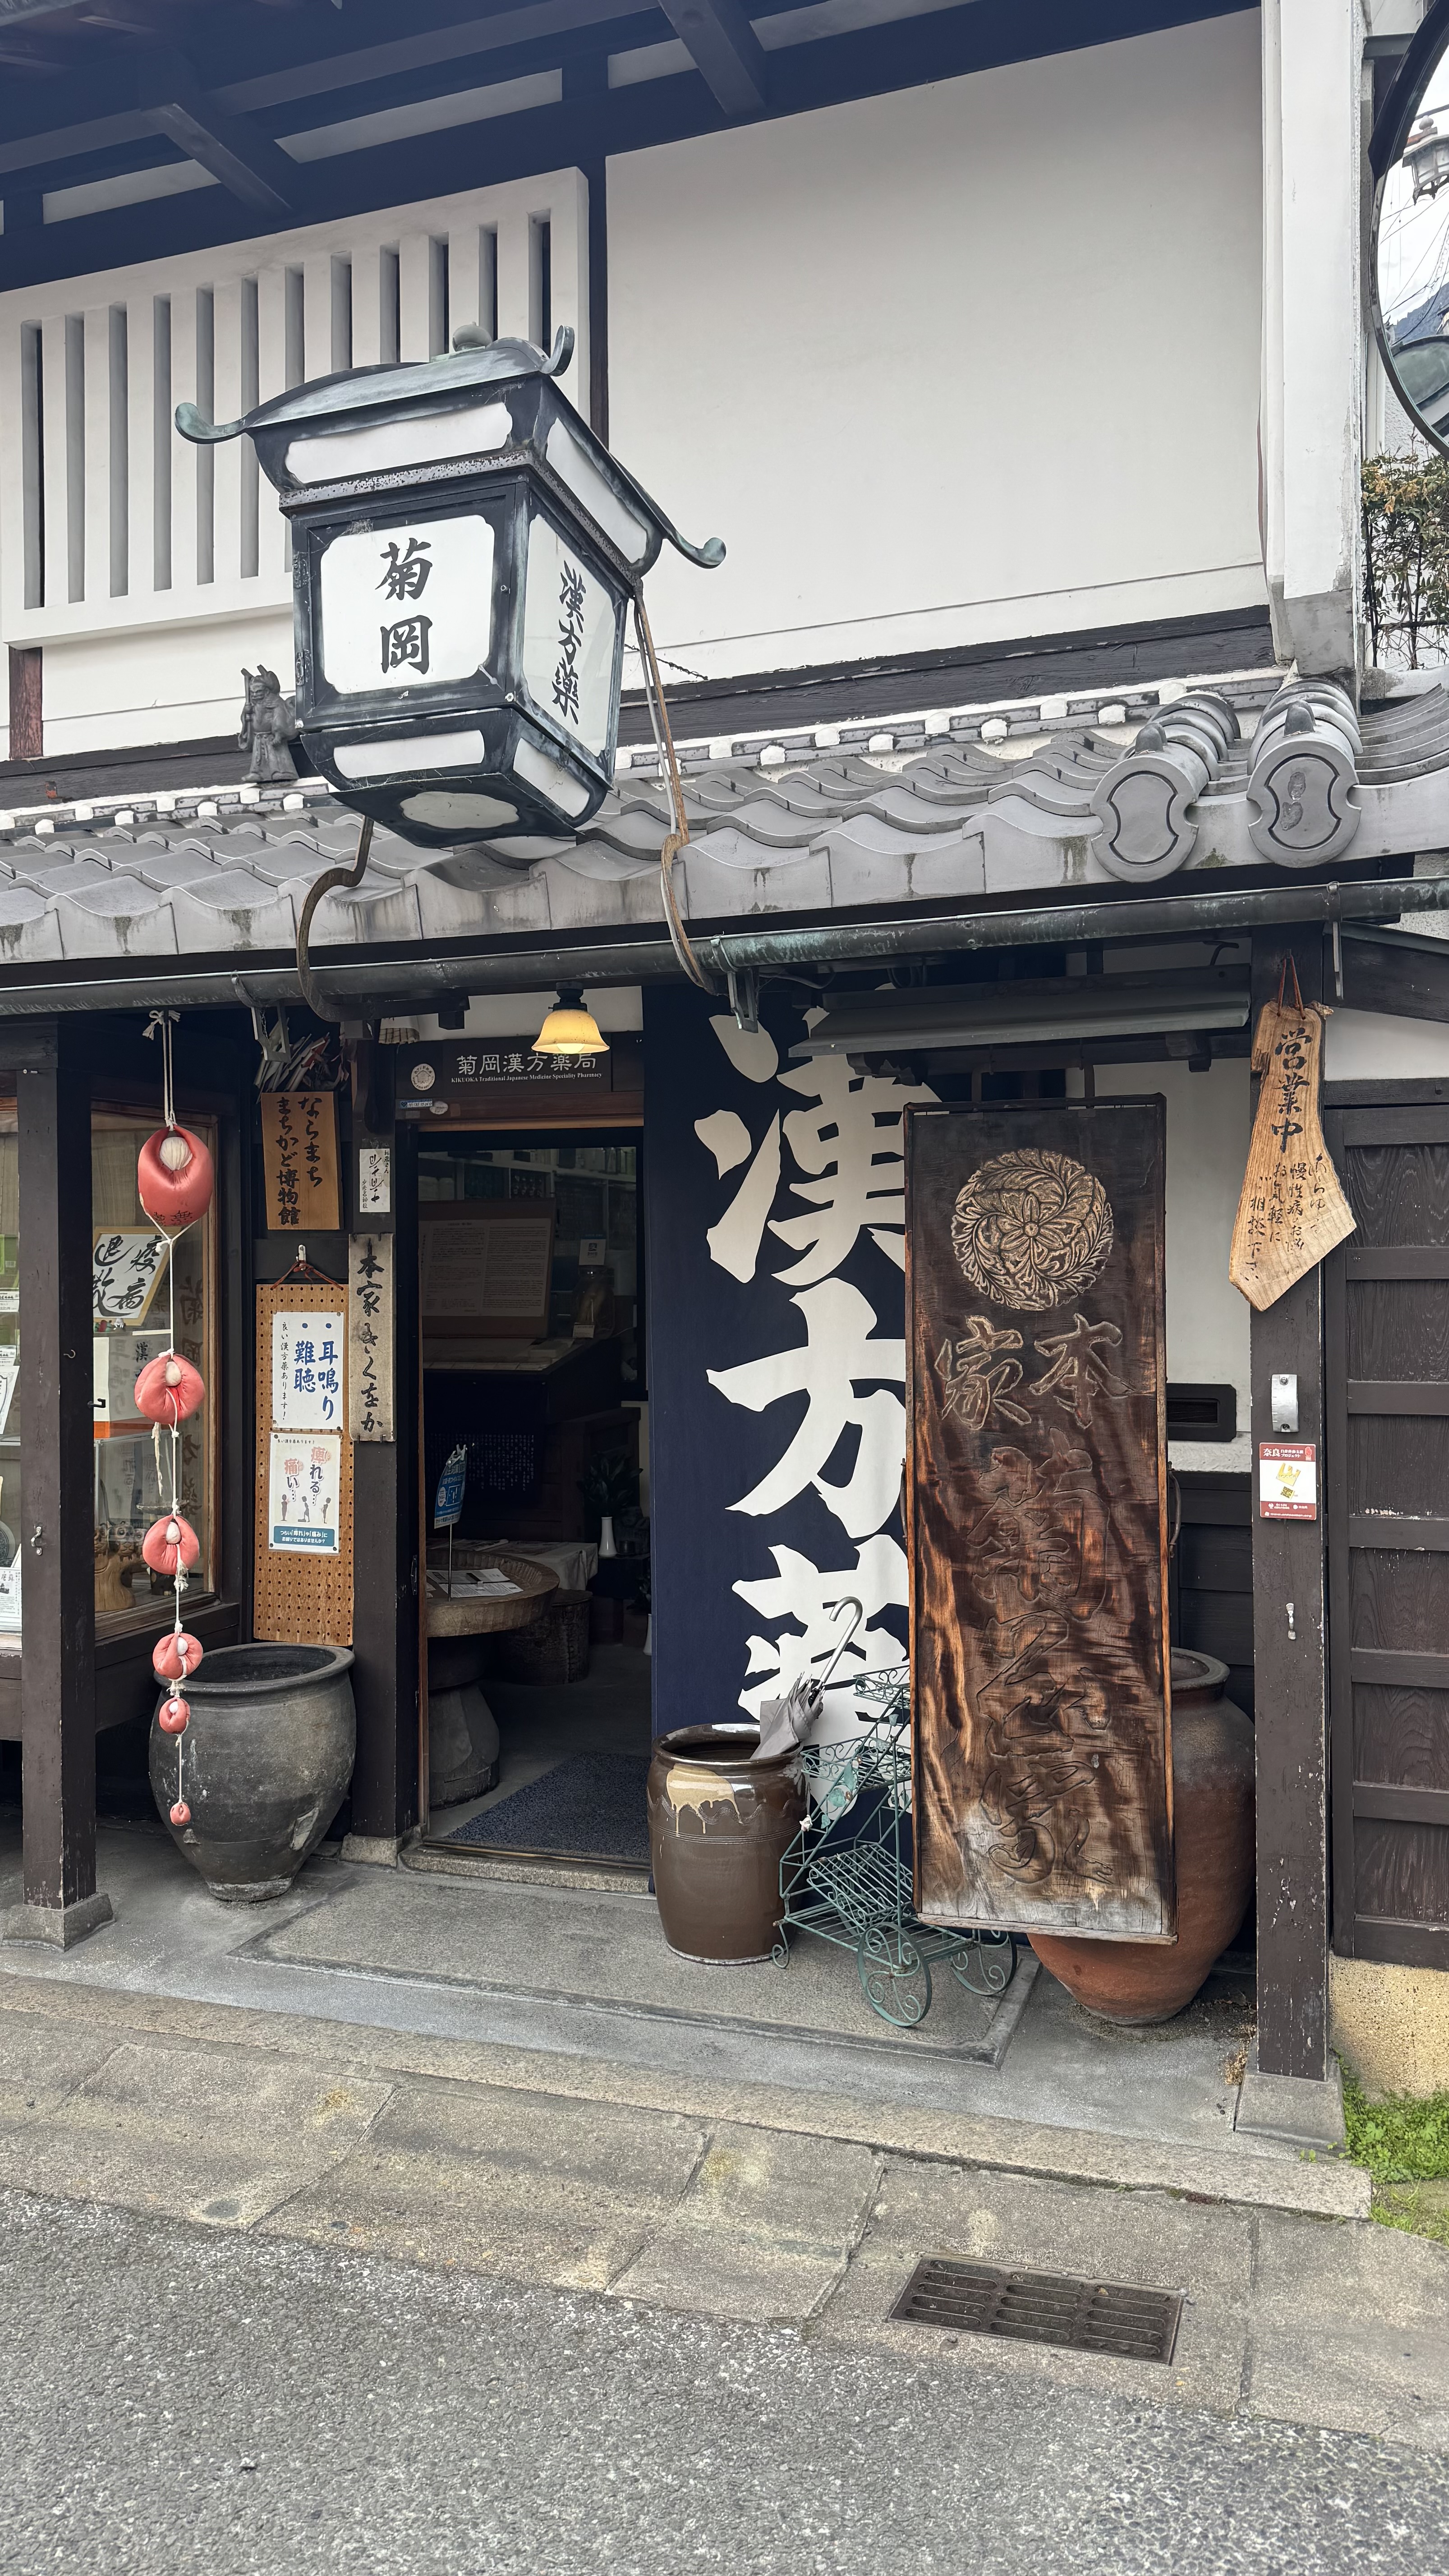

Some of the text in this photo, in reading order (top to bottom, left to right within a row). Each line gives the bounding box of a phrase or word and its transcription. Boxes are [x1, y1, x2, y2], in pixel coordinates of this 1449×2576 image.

[375, 537, 433, 675] 菊岡
[552, 559, 587, 725] 漢方薬
[456, 1052, 597, 1075] 菊岡漢方薬局
[1271, 1026, 1312, 1155] 営業中
[276, 1096, 301, 1226] まちかど博物館
[298, 1097, 323, 1187] ならまち
[293, 1341, 316, 1394] 難聴
[317, 1340, 339, 1421] 耳鳴り
[1263, 1448, 1280, 1457] 奈良
